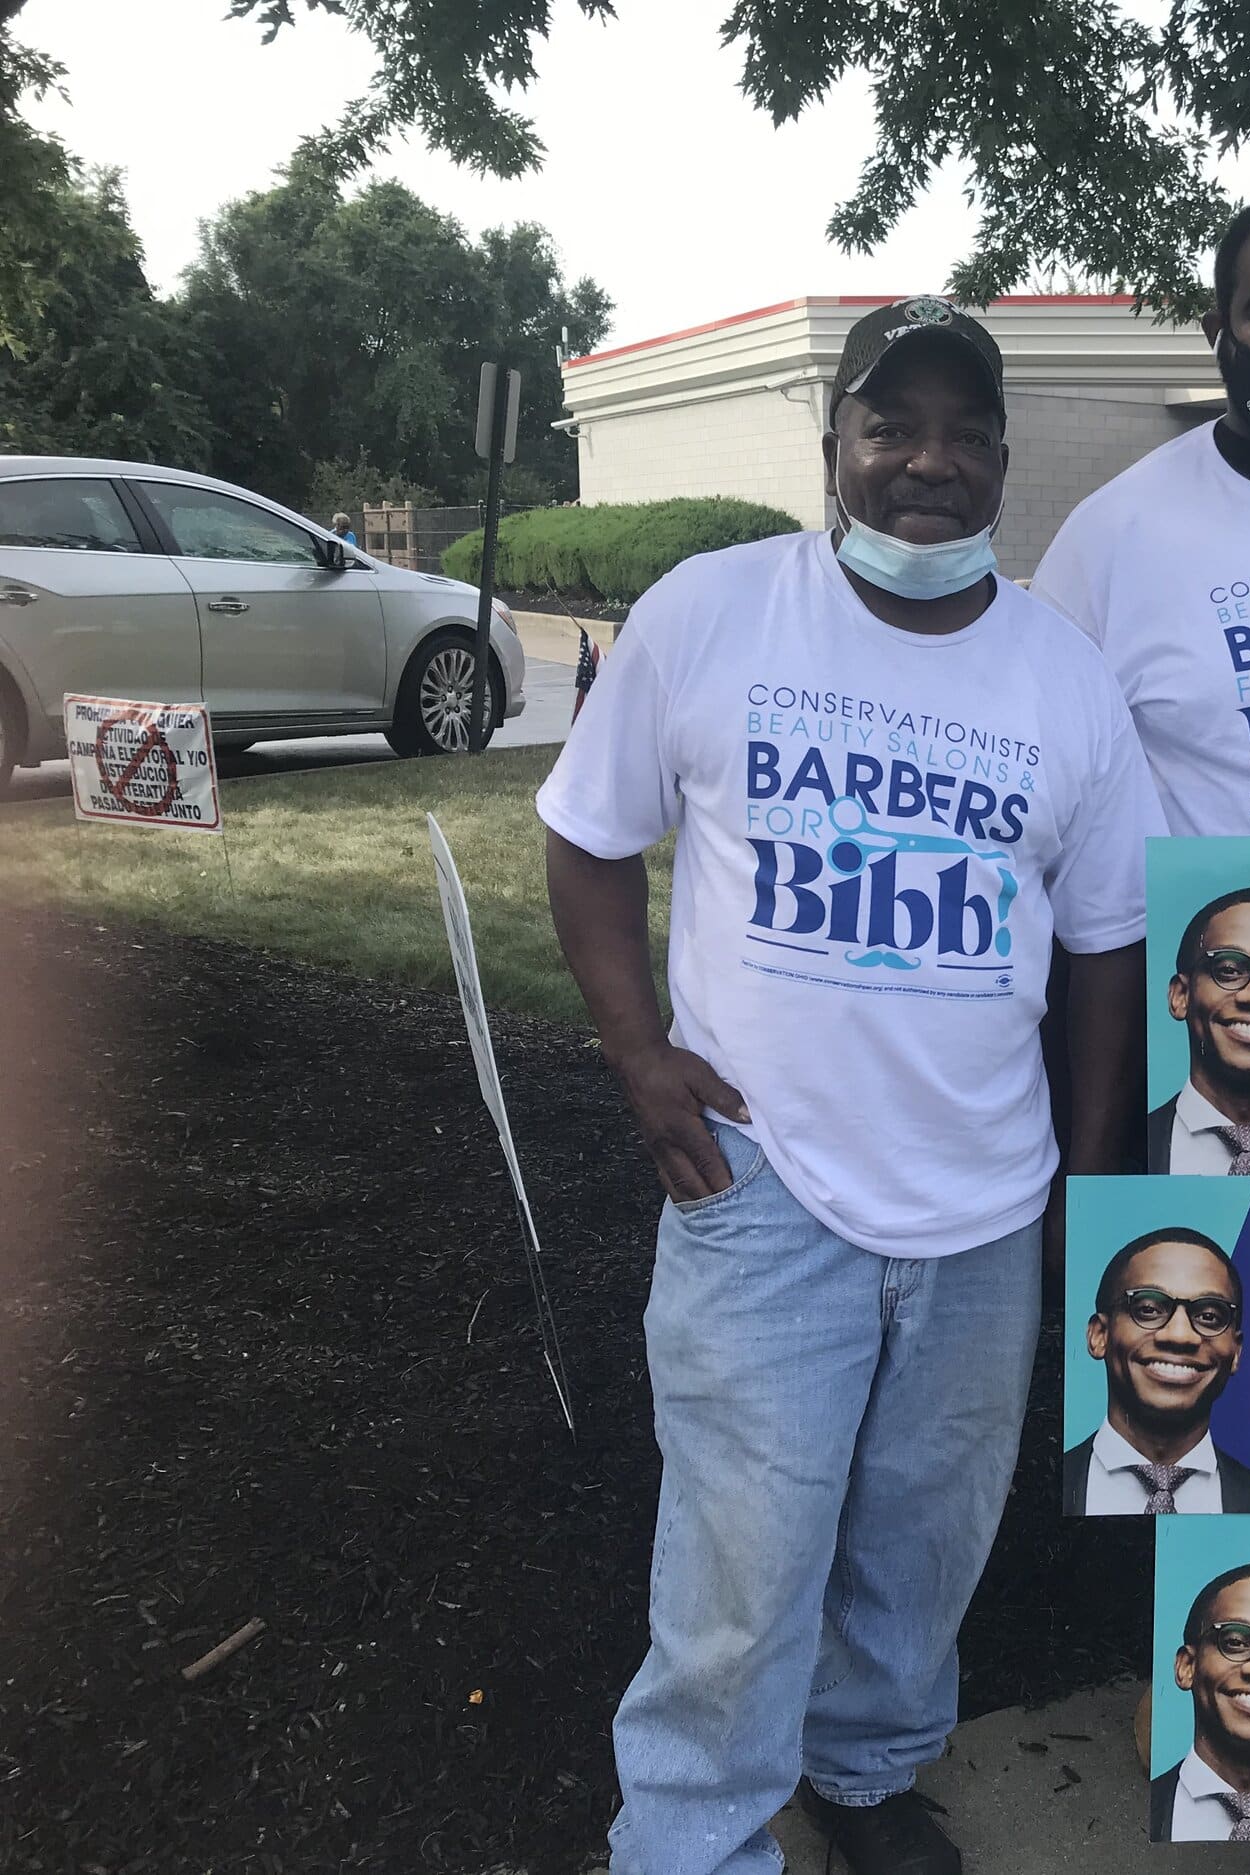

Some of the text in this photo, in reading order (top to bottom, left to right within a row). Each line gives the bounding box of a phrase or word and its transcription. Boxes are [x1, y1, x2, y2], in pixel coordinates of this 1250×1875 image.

[75, 704, 195, 729] PROHIA CQUIER
[748, 684, 1041, 767] CONSERVATIONISTS
[69, 740, 208, 767] CAMPÑA ELETORAL Y/O
[748, 711, 1036, 793] BEAUTY SALONS &
[102, 762, 174, 784] ISTRBUCIÓ
[117, 781, 183, 801] ITERATUA
[747, 740, 1030, 844] BARBERS
[748, 804, 823, 839] FOR
[745, 837, 1018, 958] Bibb!
